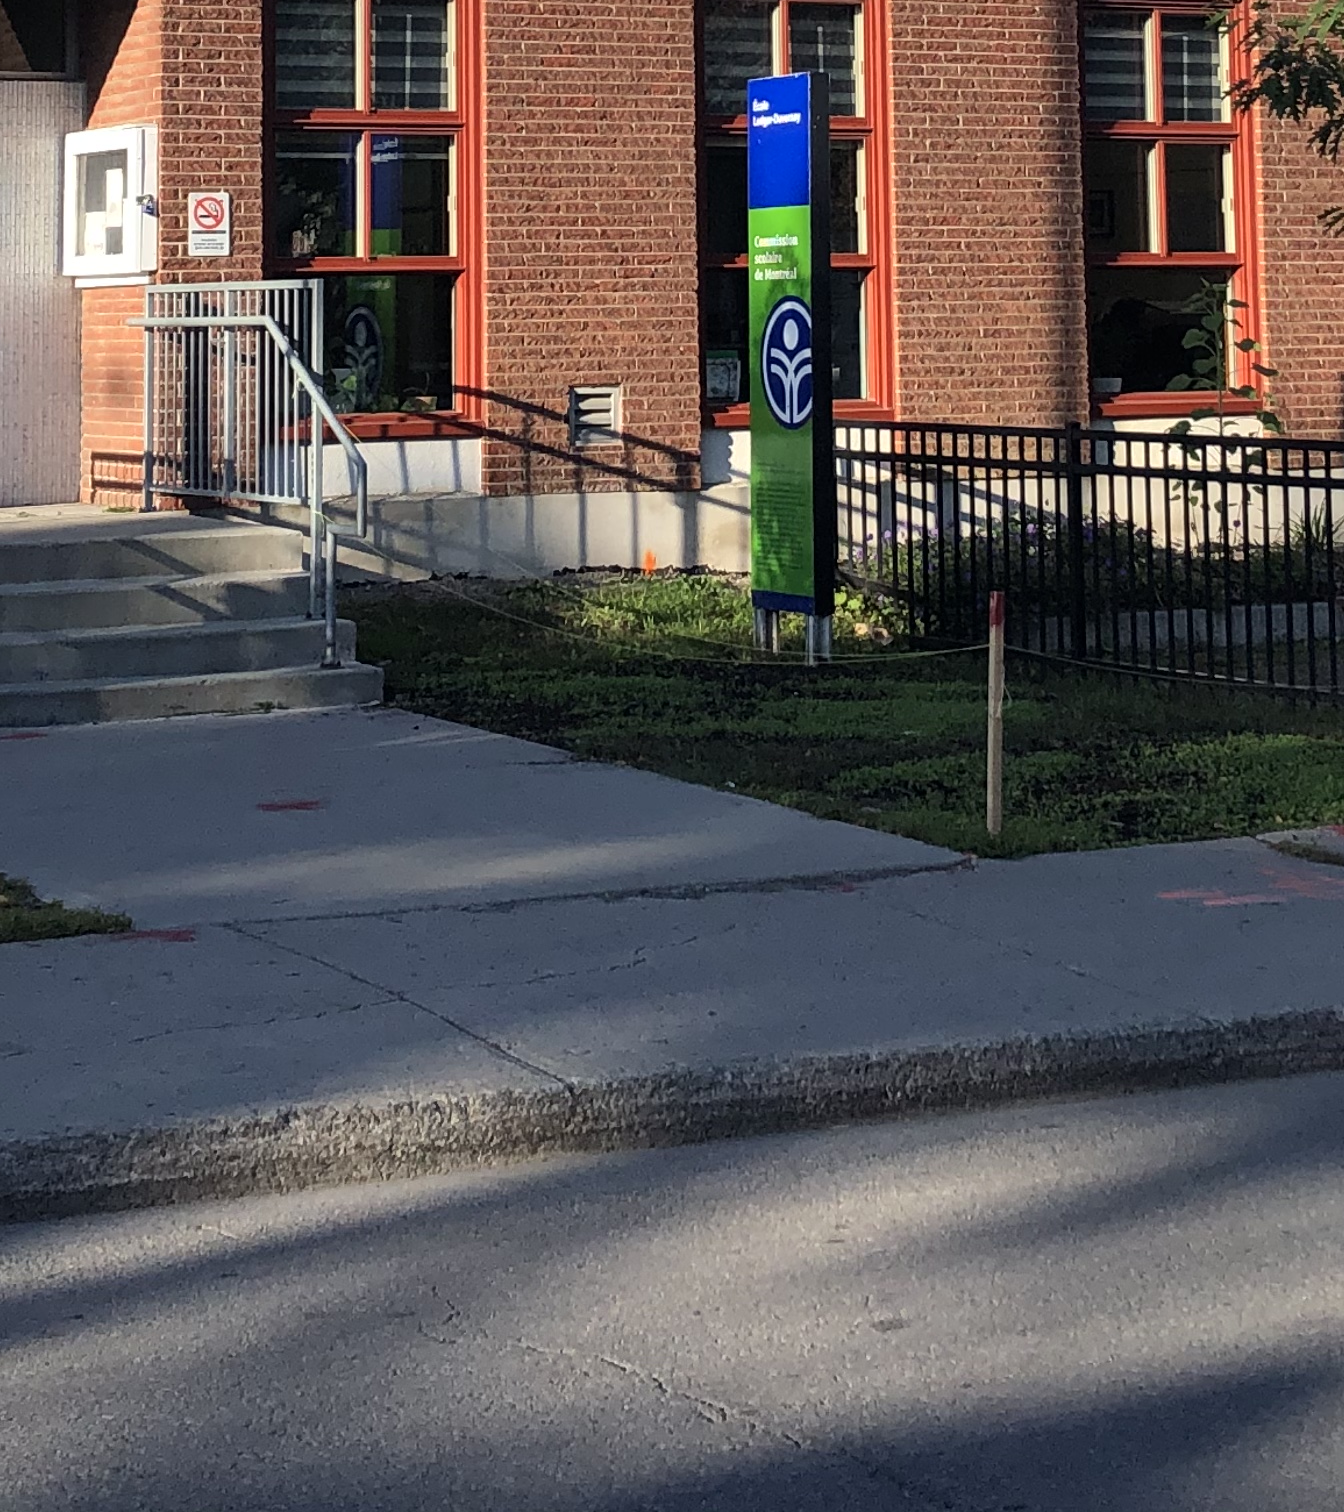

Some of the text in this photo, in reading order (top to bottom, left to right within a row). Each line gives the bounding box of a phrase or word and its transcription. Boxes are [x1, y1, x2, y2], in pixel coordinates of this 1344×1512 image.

[754, 234, 799, 248] Commission
[754, 251, 783, 265] scolaire
[754, 267, 797, 281] de Montréal
